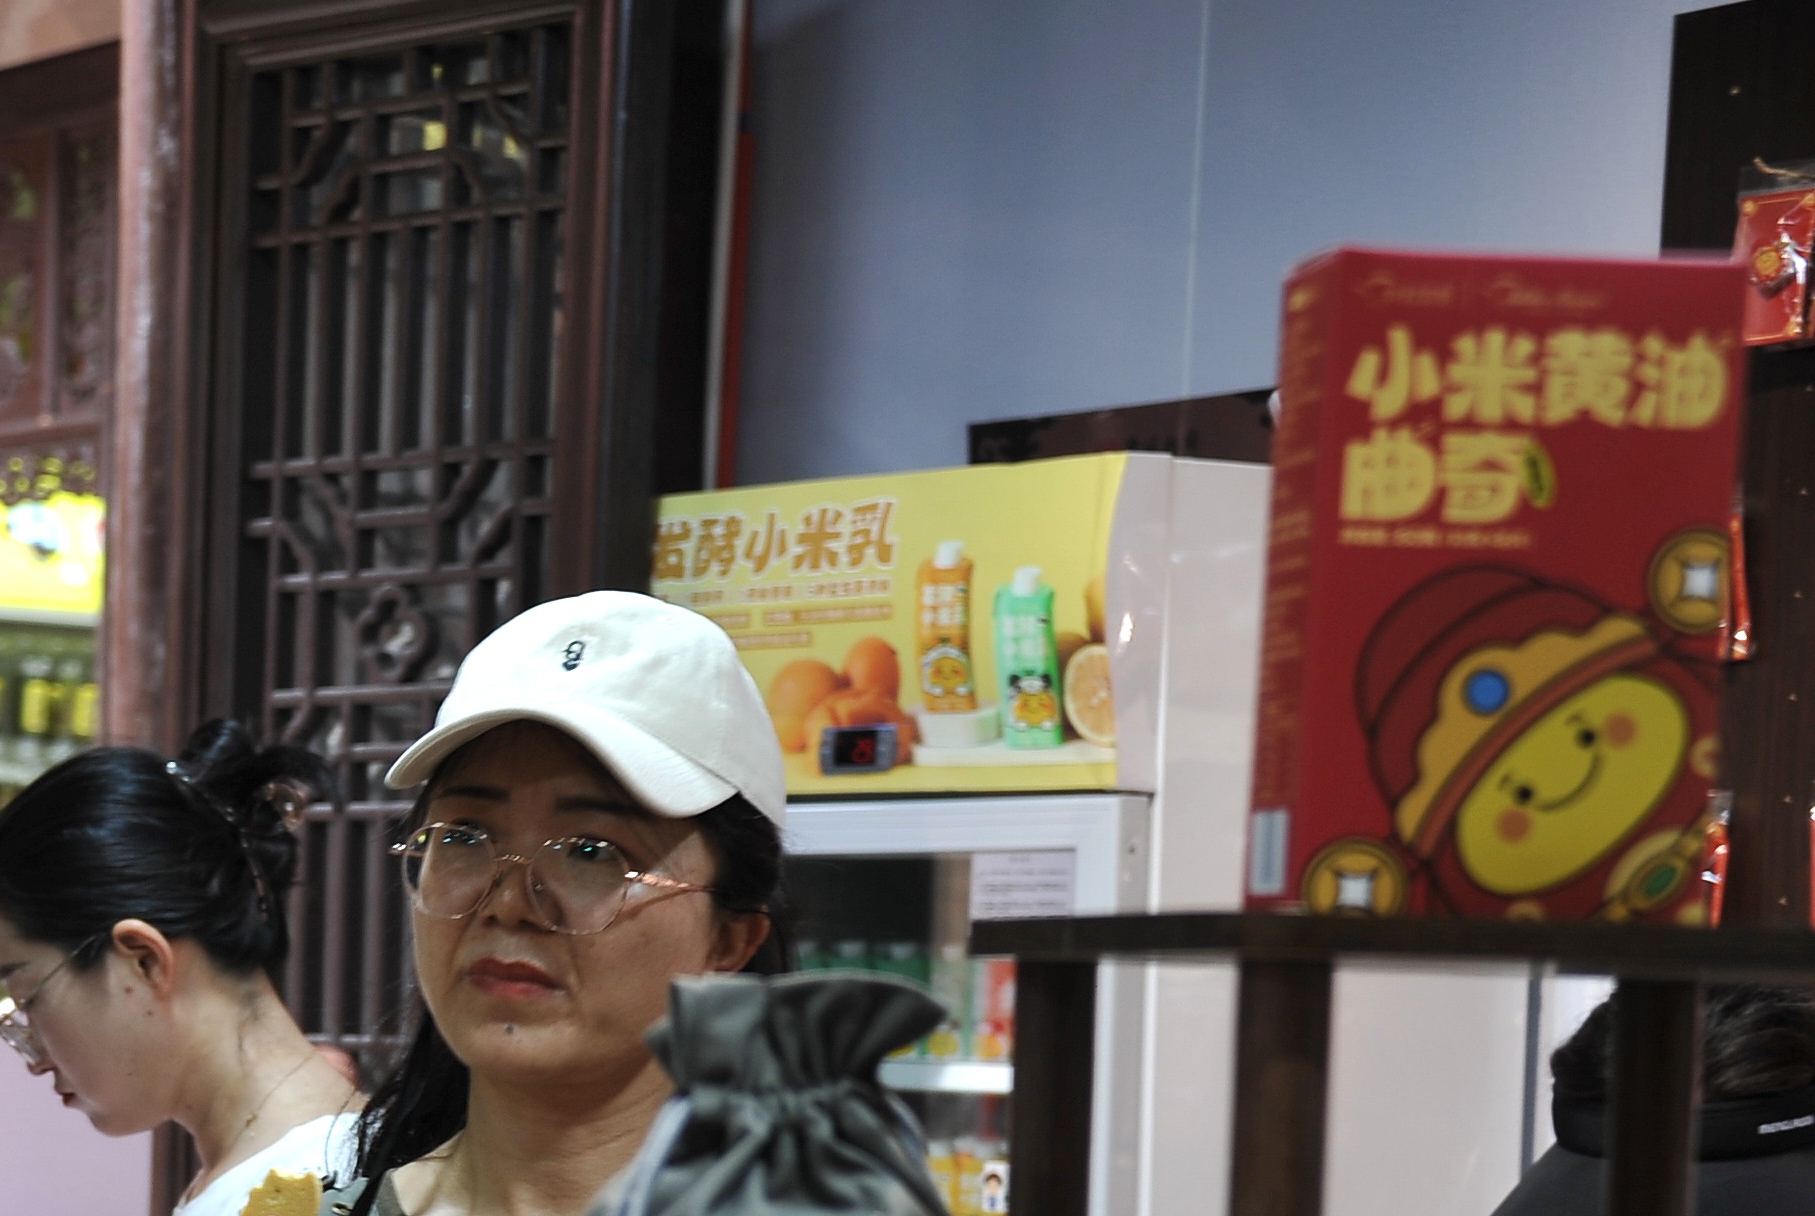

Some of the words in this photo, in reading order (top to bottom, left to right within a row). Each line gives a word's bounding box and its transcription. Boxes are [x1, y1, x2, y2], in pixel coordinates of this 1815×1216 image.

[1345, 326, 1726, 429] 小米黄油
[1340, 427, 1535, 523] 曲奇
